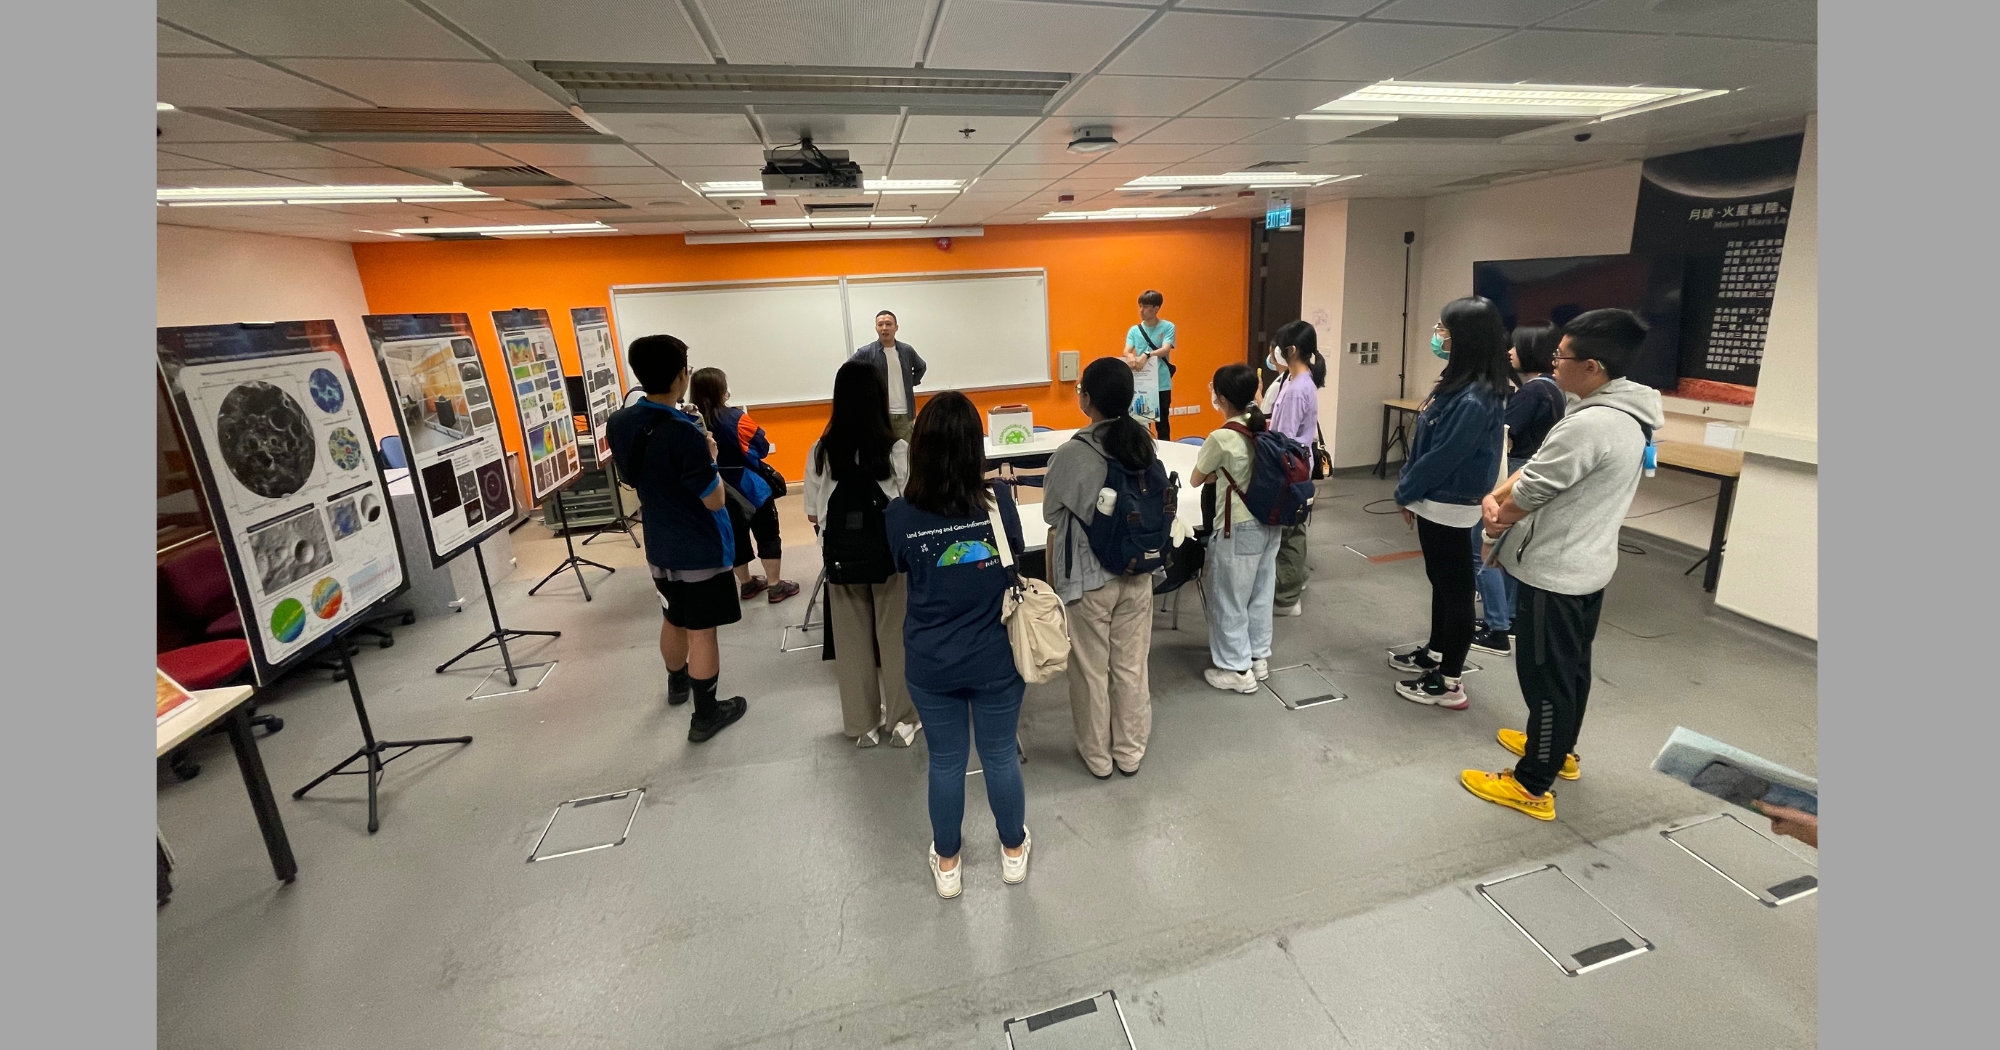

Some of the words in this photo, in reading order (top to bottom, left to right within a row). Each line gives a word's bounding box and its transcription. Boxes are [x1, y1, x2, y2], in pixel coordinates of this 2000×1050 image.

[1266, 212, 1280, 229] EXIT
[1280, 210, 1291, 226] 出口
[1747, 217, 1772, 226] Mars
[918, 528, 943, 537] Surveying
